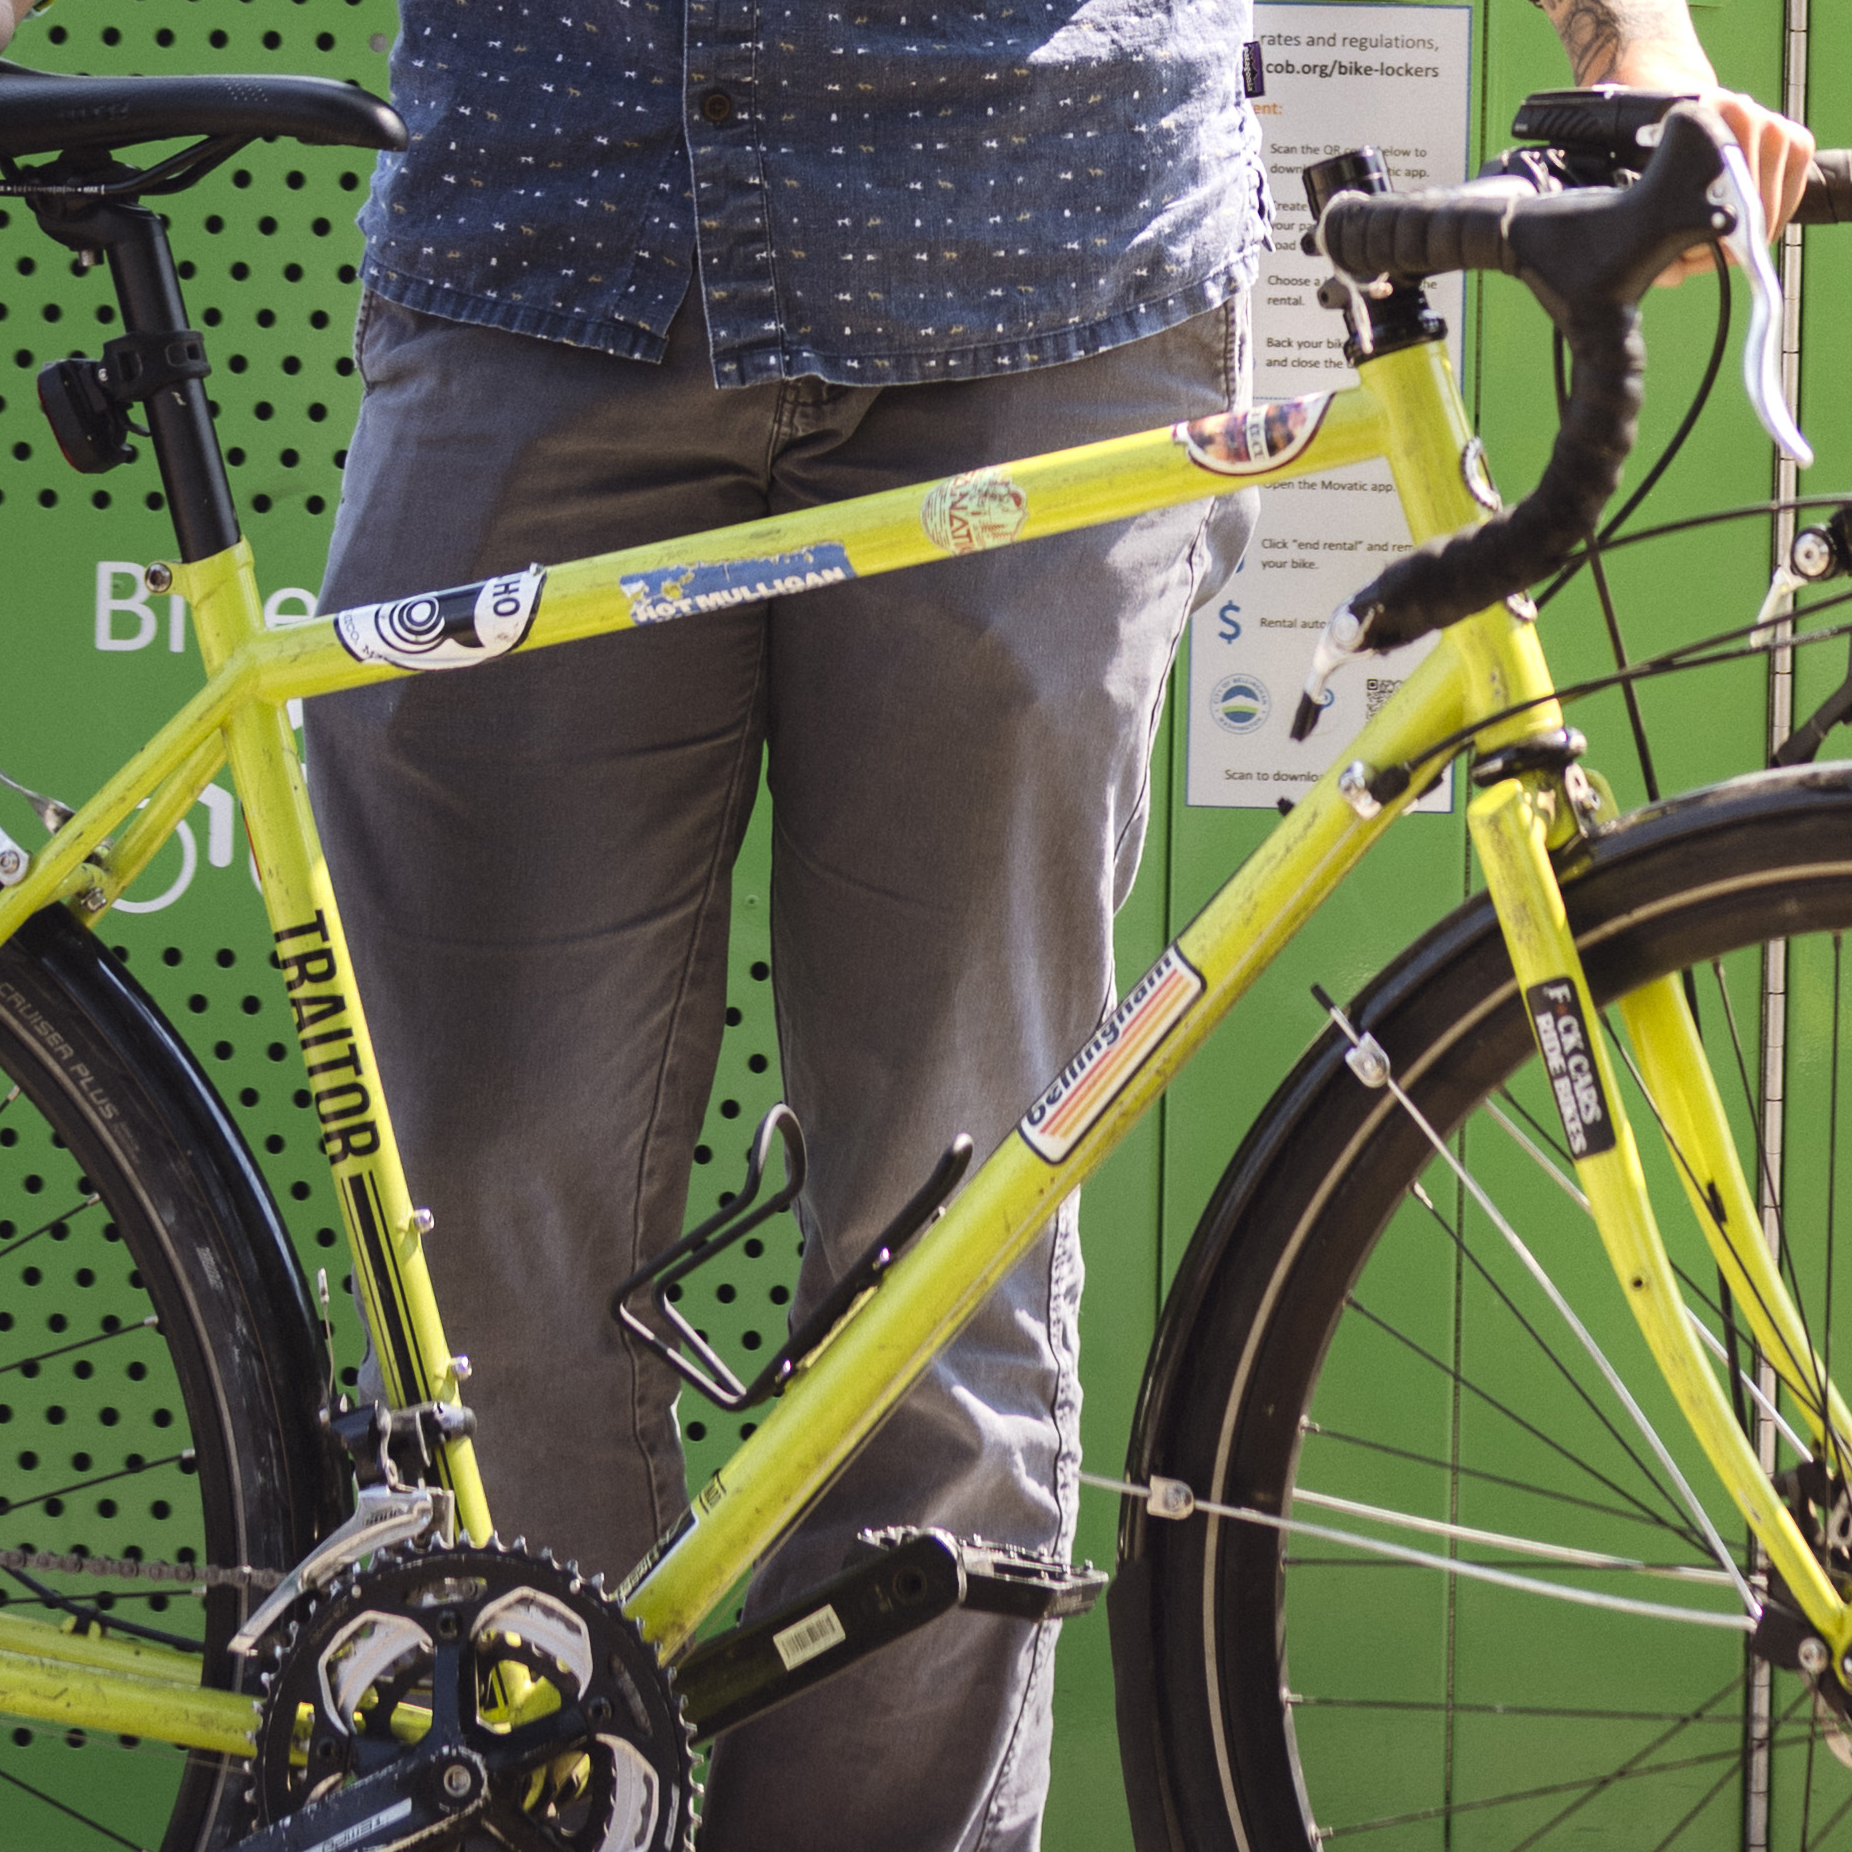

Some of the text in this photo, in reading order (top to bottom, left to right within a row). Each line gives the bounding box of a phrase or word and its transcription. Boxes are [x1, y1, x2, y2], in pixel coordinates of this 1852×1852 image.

[1260, 32, 1439, 54] rates and regulations,
[1266, 59, 1440, 79] cob.org/bike-lockers
[1270, 143, 1428, 158] Scan the QR to
[1404, 168, 1431, 183] app.
[1267, 274, 1321, 288] Choose a
[1266, 294, 1305, 307] rental.
[1265, 337, 1323, 350] Back your
[1264, 356, 1345, 369] and close the
[1297, 478, 1319, 491] the
[1319, 480, 1369, 492] Movatic
[1370, 479, 1396, 493] app.
[1260, 537, 1390, 553] Click "end rental" and
[1260, 558, 1321, 571] your bike.
[635, 565, 847, 623] HOT MULLIGAN
[94, 560, 318, 654] Bie
[1259, 617, 1298, 629] Rental
[1224, 768, 1270, 782] Scan to
[273, 908, 381, 1167] TRAITOR
[1026, 956, 1173, 1128] bellingham
[1535, 1011, 1588, 1156] RIDE BIKES
[1567, 1053, 1604, 1126] CARS
[69, 1063, 120, 1121] PLUS
